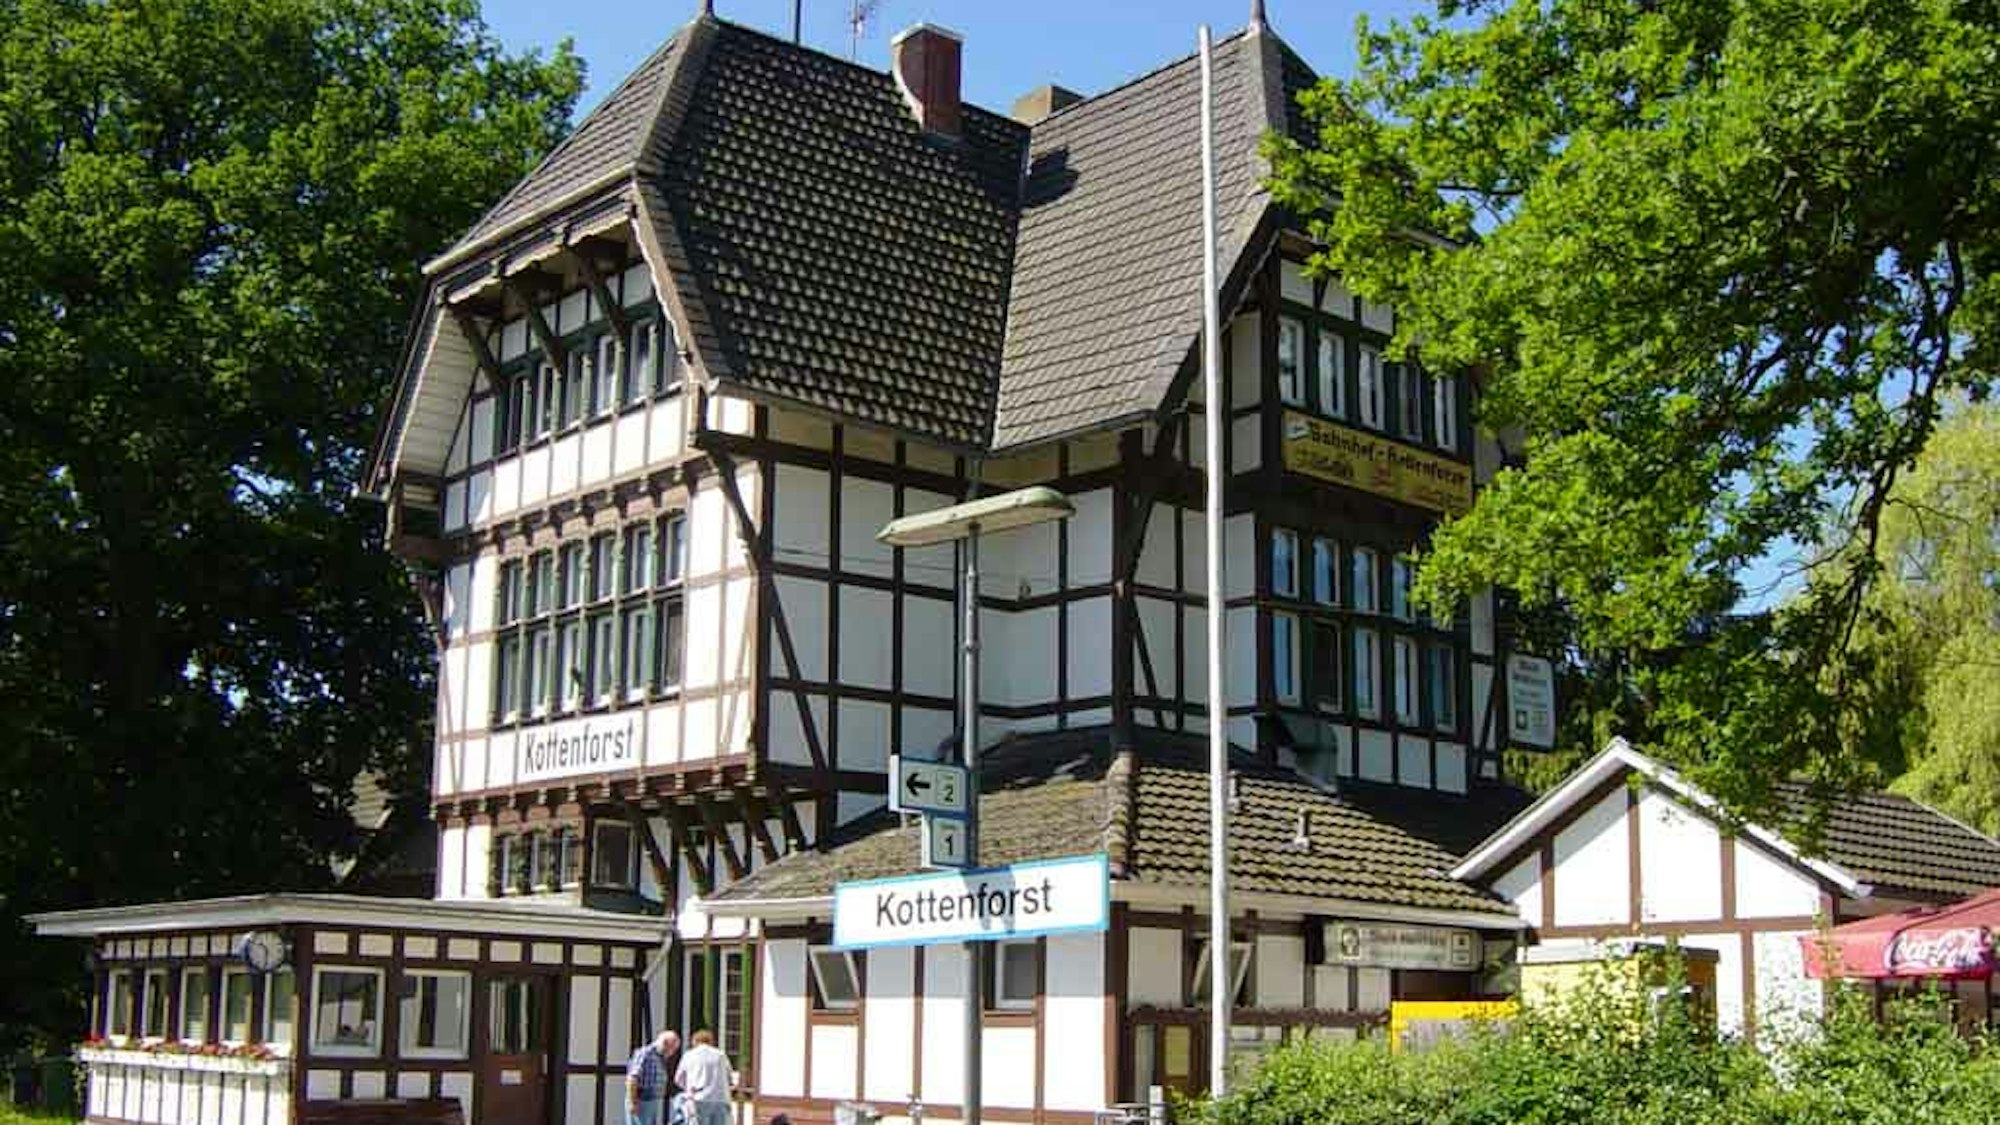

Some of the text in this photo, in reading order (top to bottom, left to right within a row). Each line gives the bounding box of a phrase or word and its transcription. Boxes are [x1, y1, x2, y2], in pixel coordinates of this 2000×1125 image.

[524, 718, 633, 774] Kottenforst
[944, 784, 954, 803] 2
[944, 835, 953, 856] 1
[876, 877, 1052, 928] Kottenforst
[1884, 927, 1986, 970] Coca-Cola
